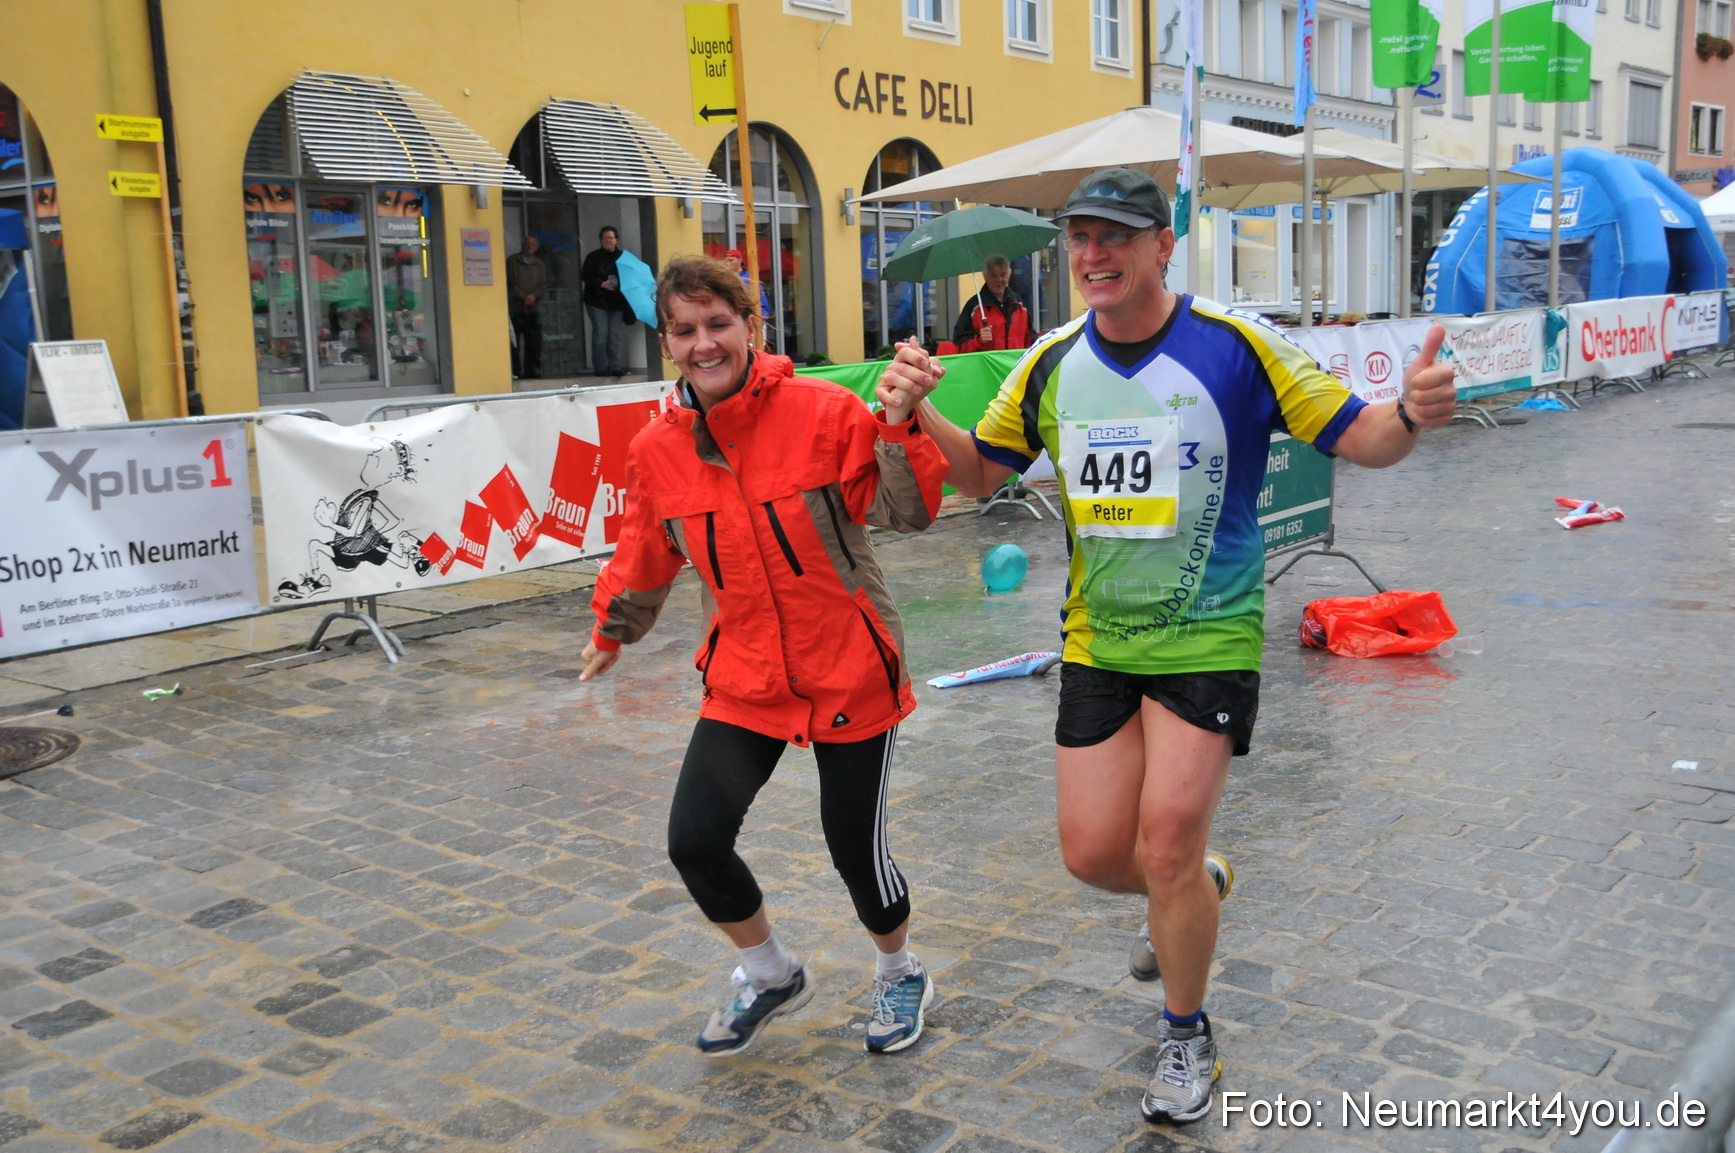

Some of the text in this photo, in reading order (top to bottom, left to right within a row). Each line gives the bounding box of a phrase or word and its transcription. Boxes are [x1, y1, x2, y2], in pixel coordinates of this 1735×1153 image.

[690, 37, 733, 59] Jugend
[705, 60, 727, 77] lauf
[835, 67, 973, 126] CAFE DELI
[1581, 312, 1657, 362] Oberbank
[1367, 358, 1387, 377] KIA
[1363, 386, 1398, 401] KIA MOTORS
[1088, 426, 1139, 440] BOCK
[1080, 450, 1152, 494] 449
[1267, 447, 1290, 474] heit
[544, 487, 586, 528] Braun
[603, 483, 627, 517] Br
[1257, 484, 1274, 509] nt!
[1093, 504, 1133, 521] Peter
[503, 508, 534, 547] Braun
[1264, 519, 1303, 543] 09181 6352
[0, 530, 241, 583] Shop 2x in Neumarkt
[458, 532, 486, 557] Braun
[20, 603, 37, 614] Am
[38, 596, 79, 611] Berliner
[80, 593, 102, 604] Ring:
[189, 579, 198, 589] 21
[22, 619, 43, 632] und
[43, 617, 56, 627] im
[58, 611, 102, 626] Zentrum:
[102, 607, 126, 619] Obere
[126, 599, 171, 615] Marktstraße
